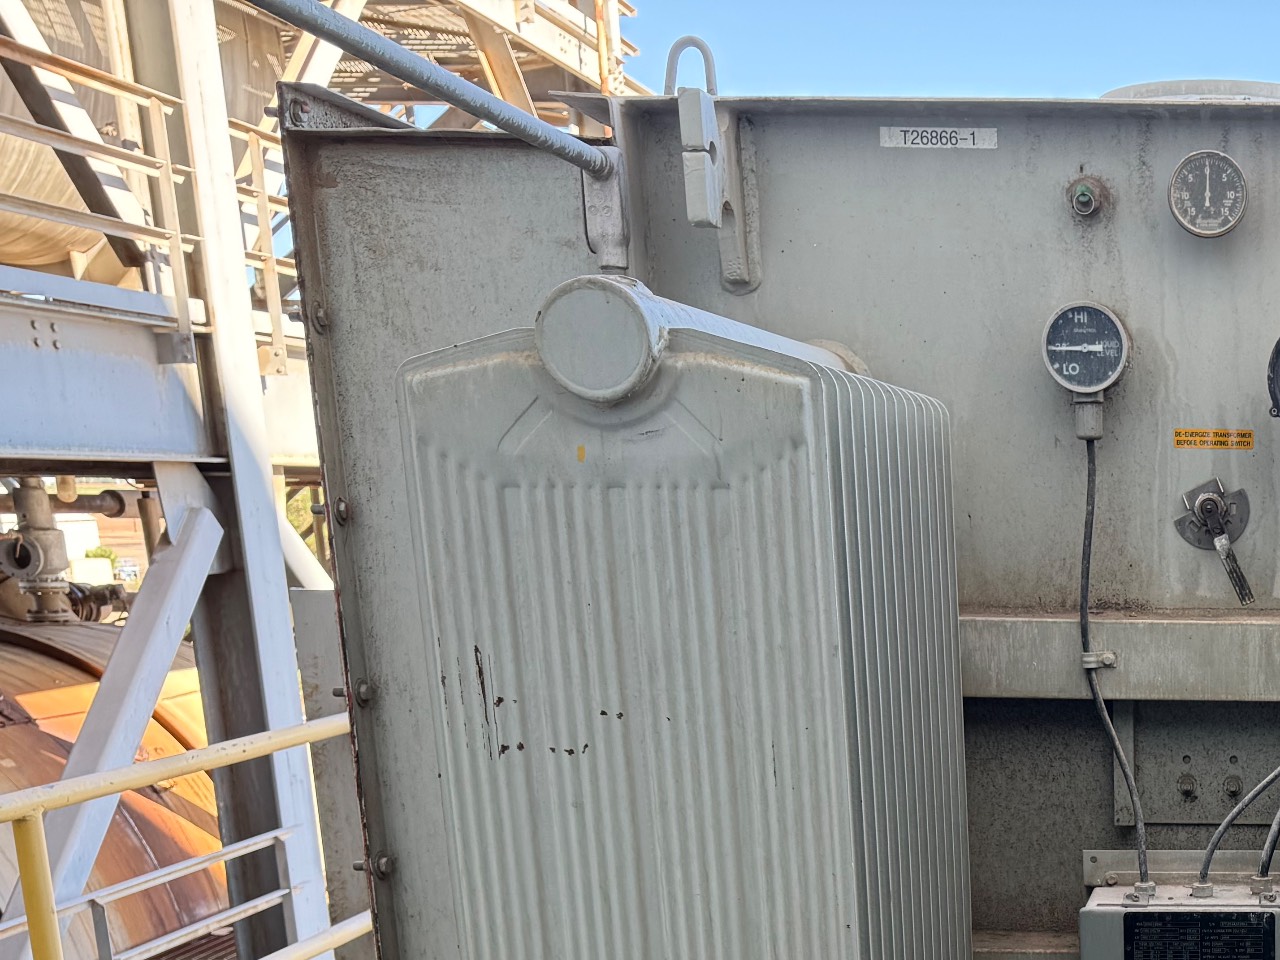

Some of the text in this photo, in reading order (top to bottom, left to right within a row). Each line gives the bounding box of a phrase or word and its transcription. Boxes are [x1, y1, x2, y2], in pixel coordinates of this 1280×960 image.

[900, 130, 976, 146] T26866-1
[1188, 174, 1194, 182] 5
[1222, 174, 1227, 182] 5
[1188, 207, 1196, 215] 15
[1074, 312, 1087, 323] HI
[1063, 363, 1079, 375] LO
[1212, 431, 1252, 439] TRANSFORMER
